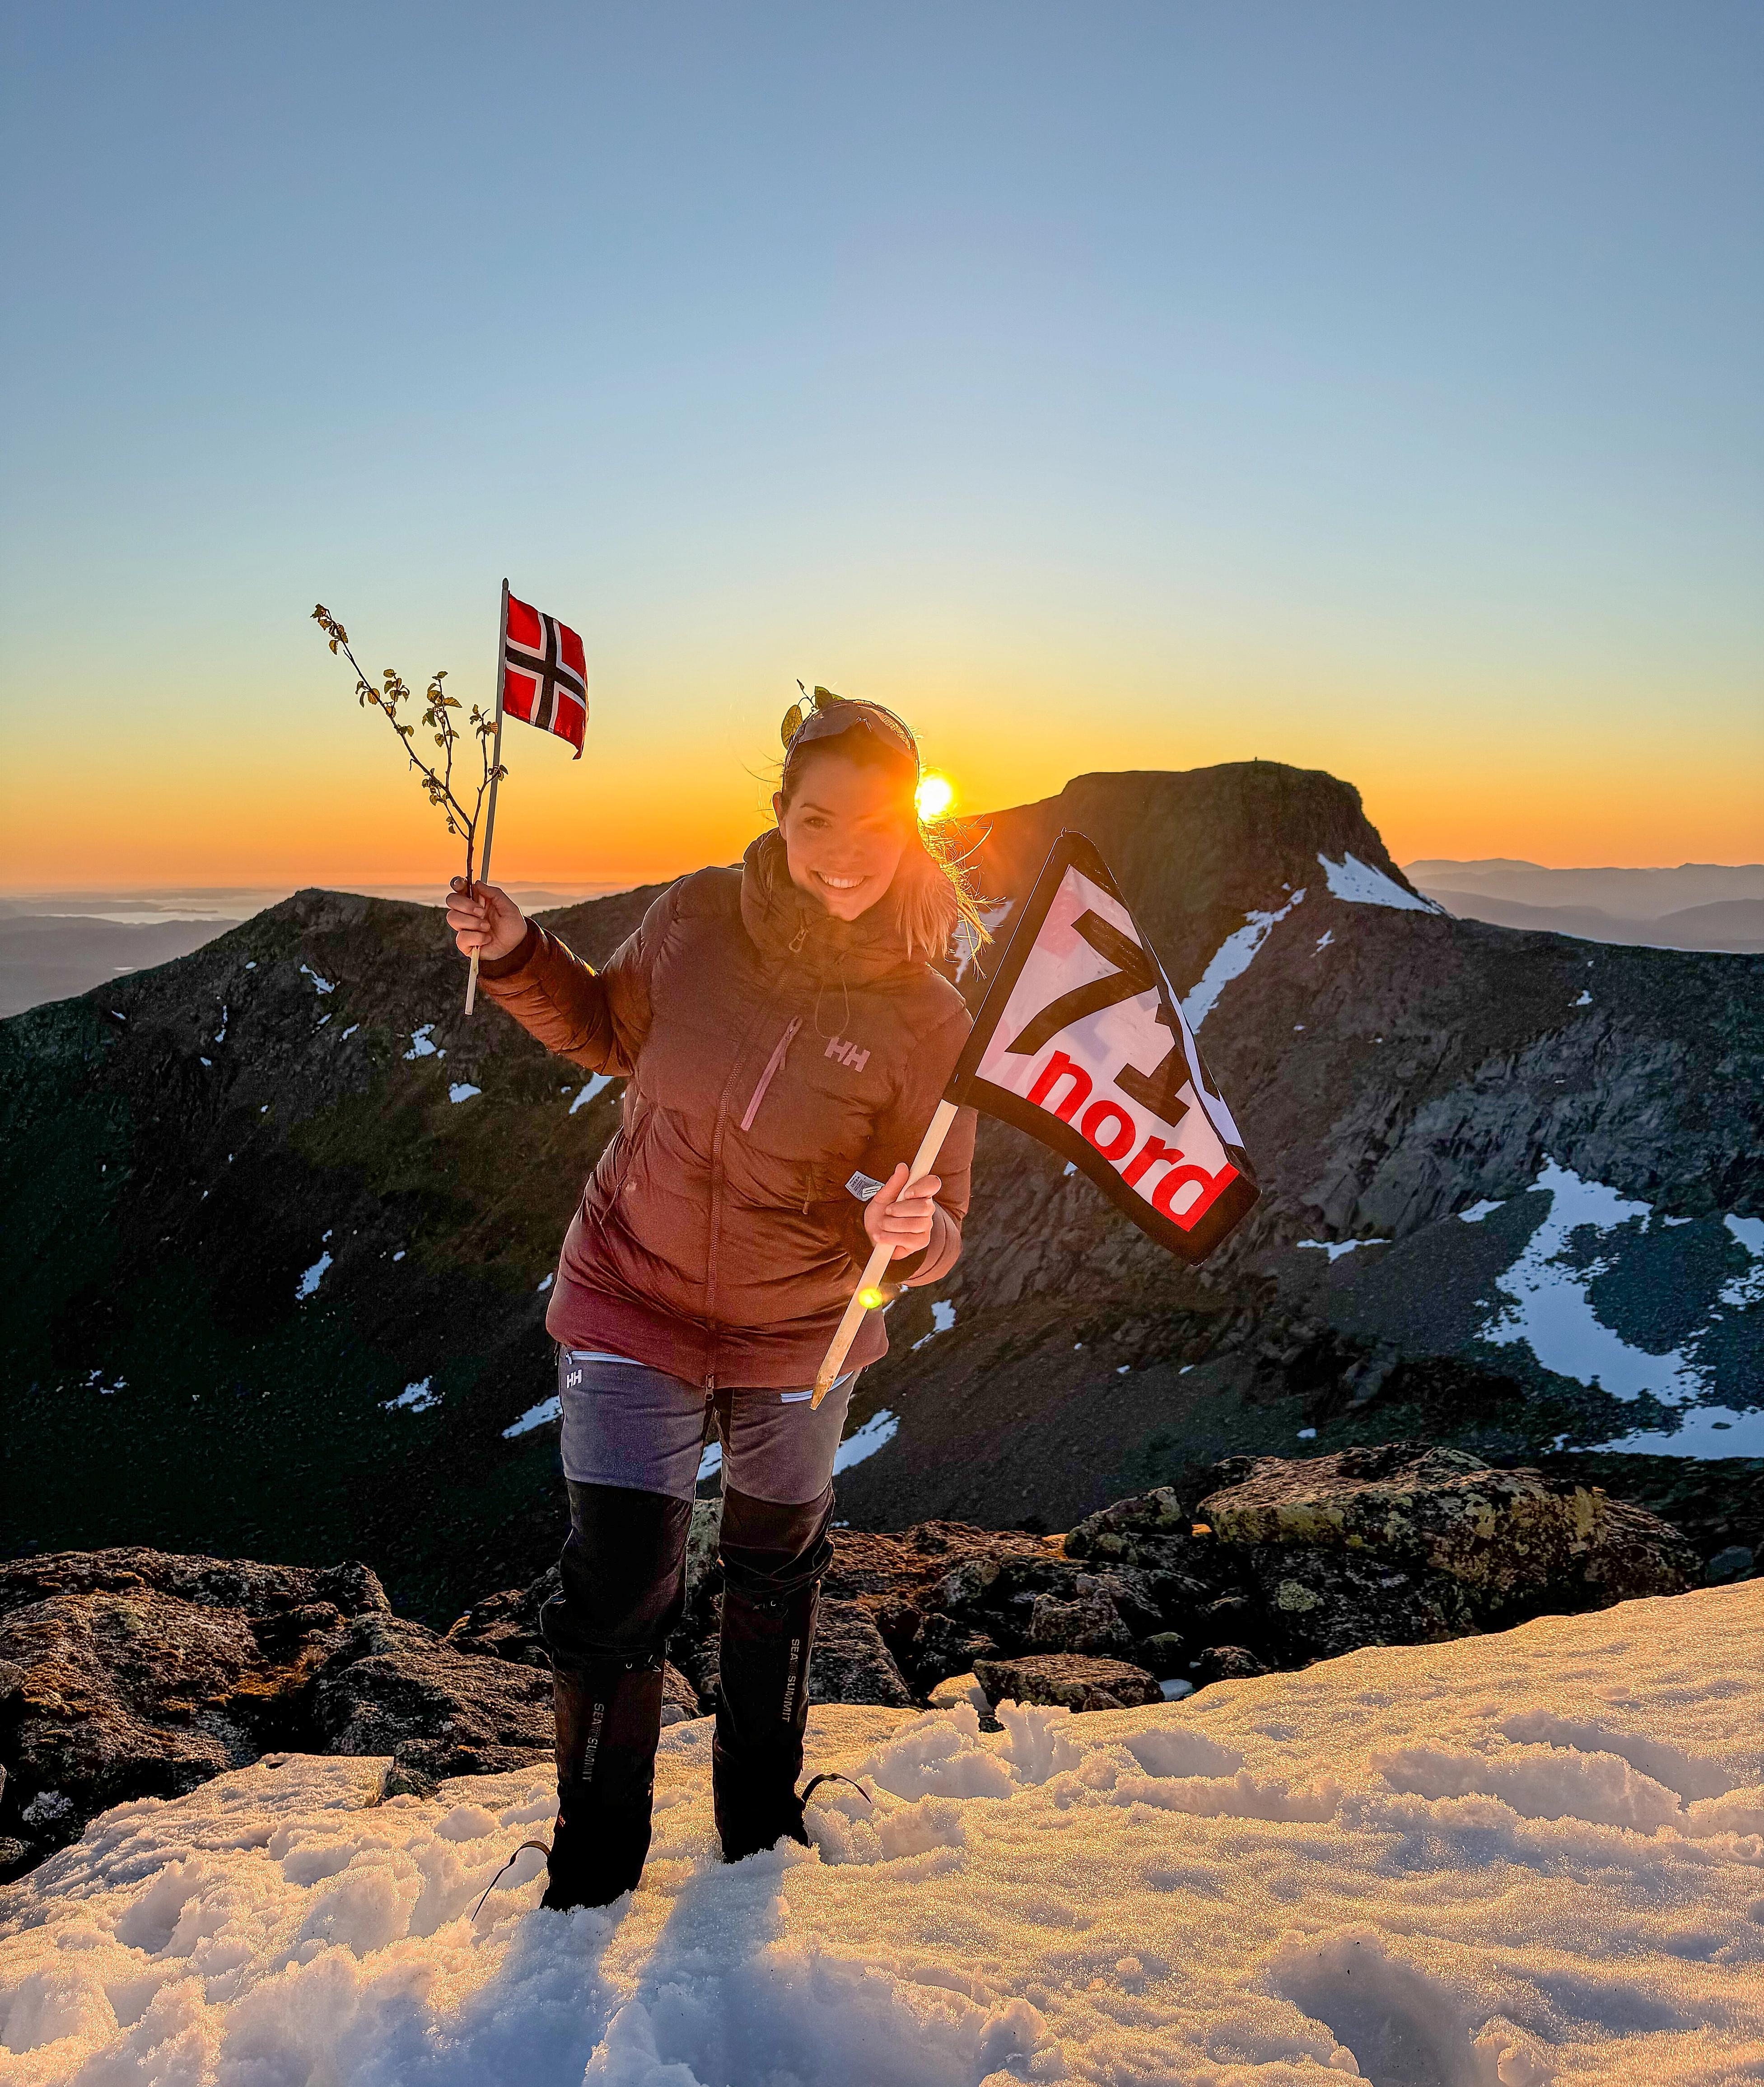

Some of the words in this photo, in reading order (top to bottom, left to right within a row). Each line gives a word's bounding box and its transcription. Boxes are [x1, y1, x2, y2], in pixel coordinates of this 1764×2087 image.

[824, 1037, 871, 1072] HH
[1026, 1050, 1240, 1232] nord
[566, 1369, 582, 1389] HH
